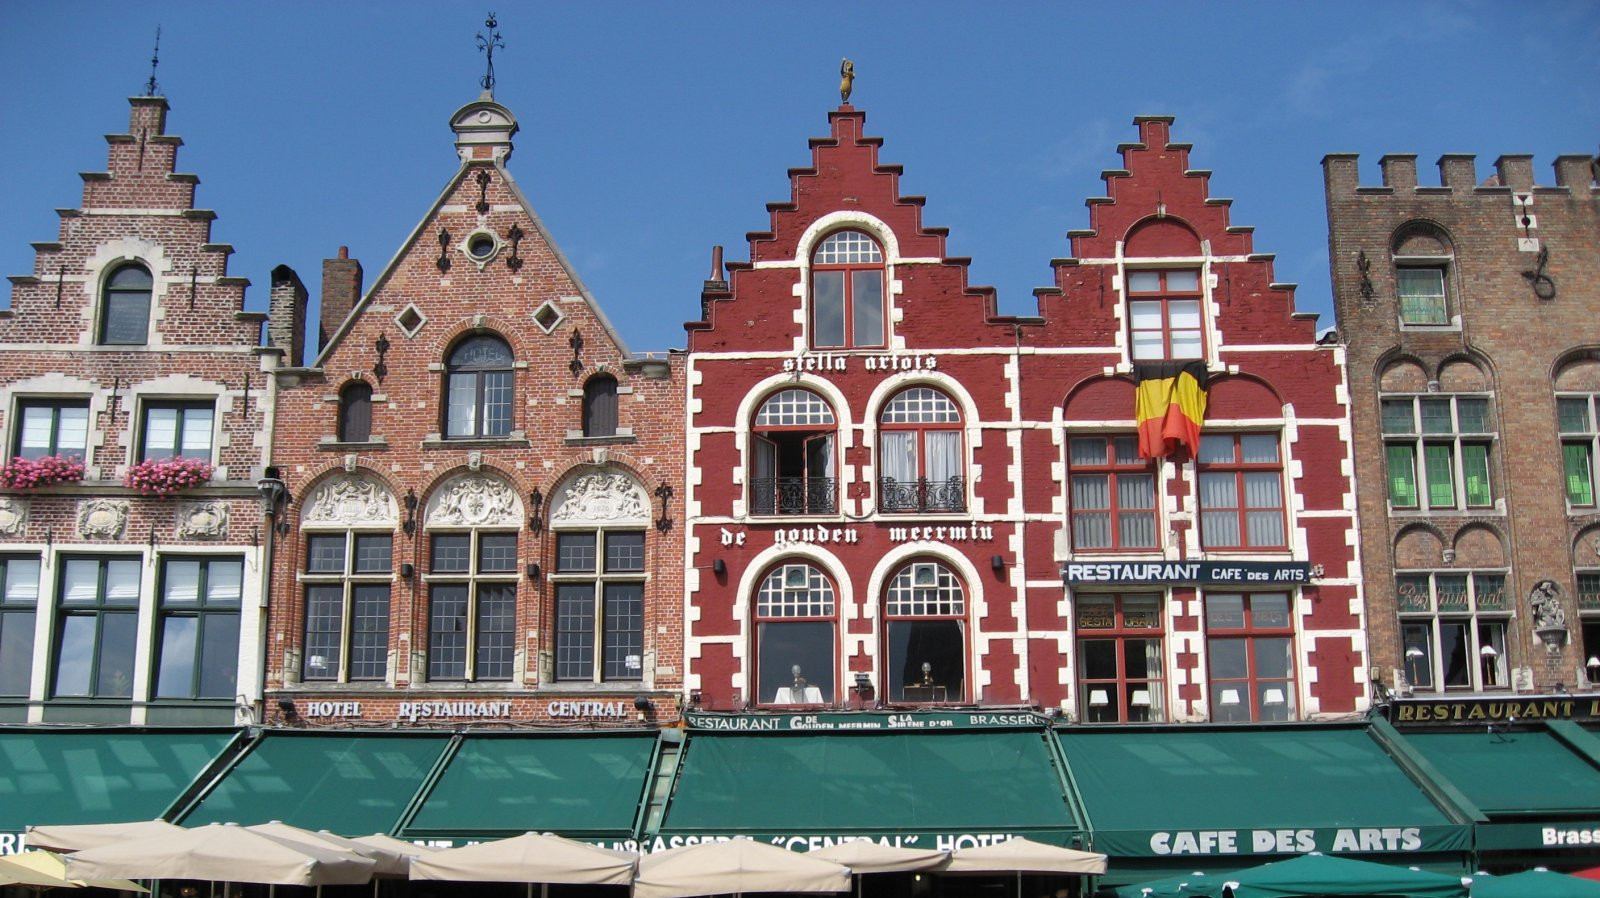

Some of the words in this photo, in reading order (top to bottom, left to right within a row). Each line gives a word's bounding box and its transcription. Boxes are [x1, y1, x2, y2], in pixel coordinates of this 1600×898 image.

[783, 353, 847, 371] stella
[865, 353, 937, 371] artois
[720, 527, 746, 546] de
[774, 524, 858, 546] gouden
[889, 521, 993, 543] meermin
[1068, 564, 1200, 580] RESTAURANT
[1211, 568, 1242, 580] CAFE
[1247, 572, 1269, 580] DES
[1274, 569, 1304, 581] ARTS
[307, 701, 363, 717] HOTEL
[399, 701, 512, 717] RESTAURANT
[548, 701, 627, 717] CENTRAL
[1399, 701, 1575, 721] RESTAURANT
[688, 716, 780, 730] RESTAURANT
[1150, 831, 1237, 854] CAFE
[1252, 830, 1316, 853] DES
[1332, 828, 1421, 851] ARTS
